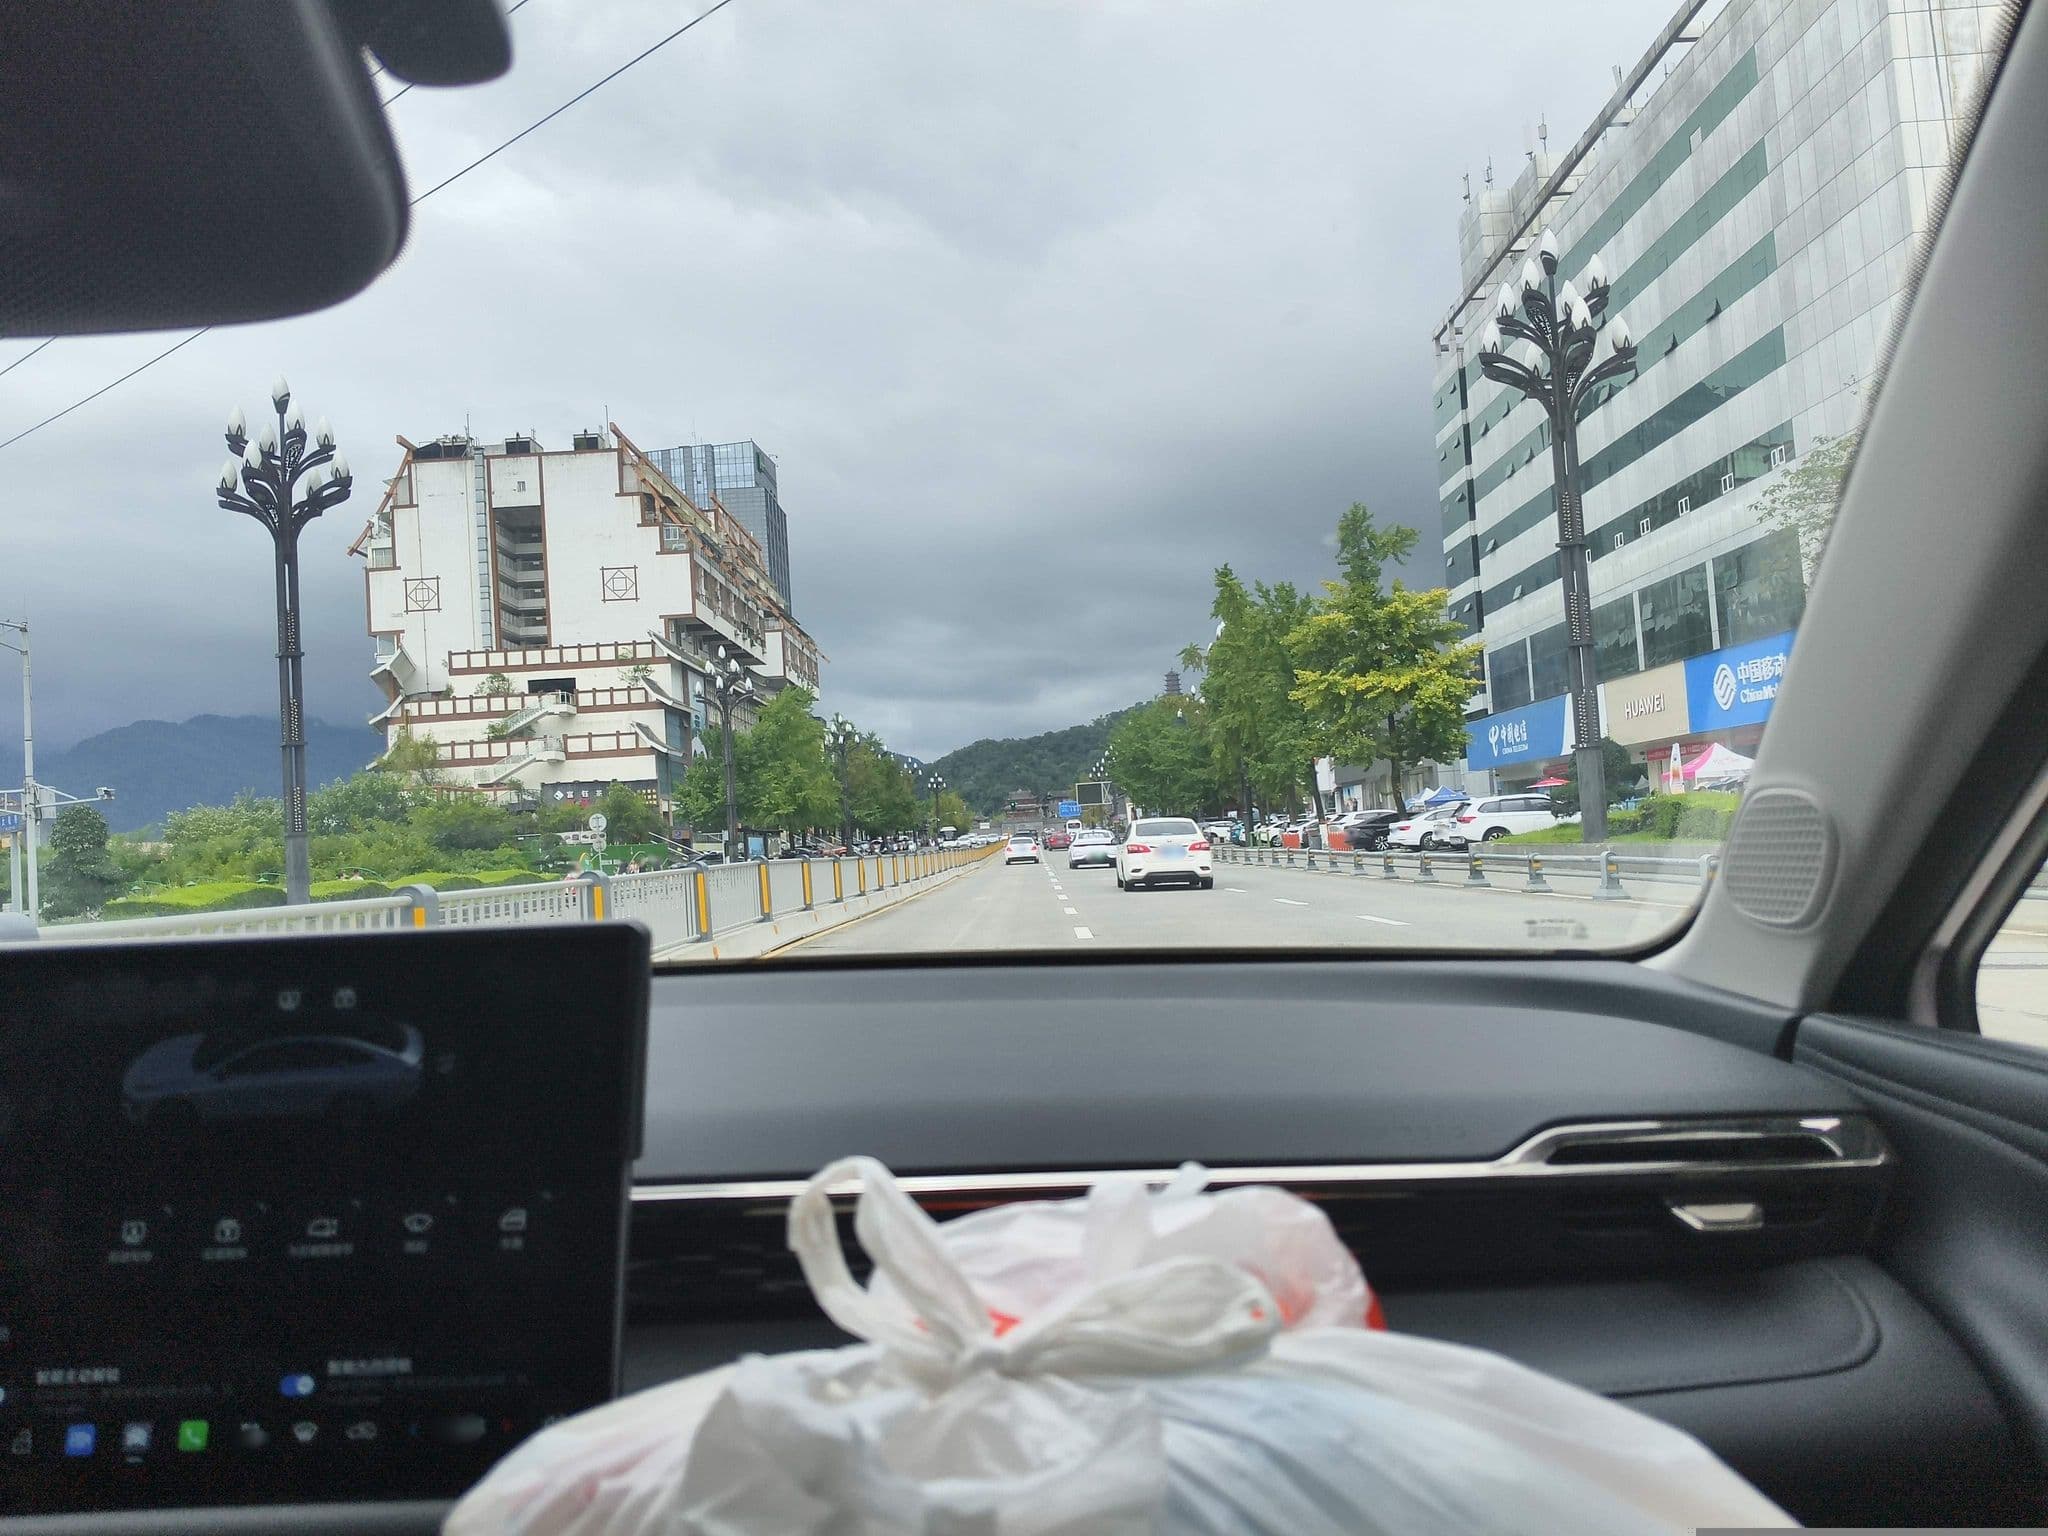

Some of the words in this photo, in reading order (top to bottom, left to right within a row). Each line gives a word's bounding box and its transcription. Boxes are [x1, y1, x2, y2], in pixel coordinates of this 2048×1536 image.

[1737, 652, 1786, 685] 中国移动
[1624, 693, 1665, 720] HUAWEI
[1500, 719, 1527, 747] 中国电信
